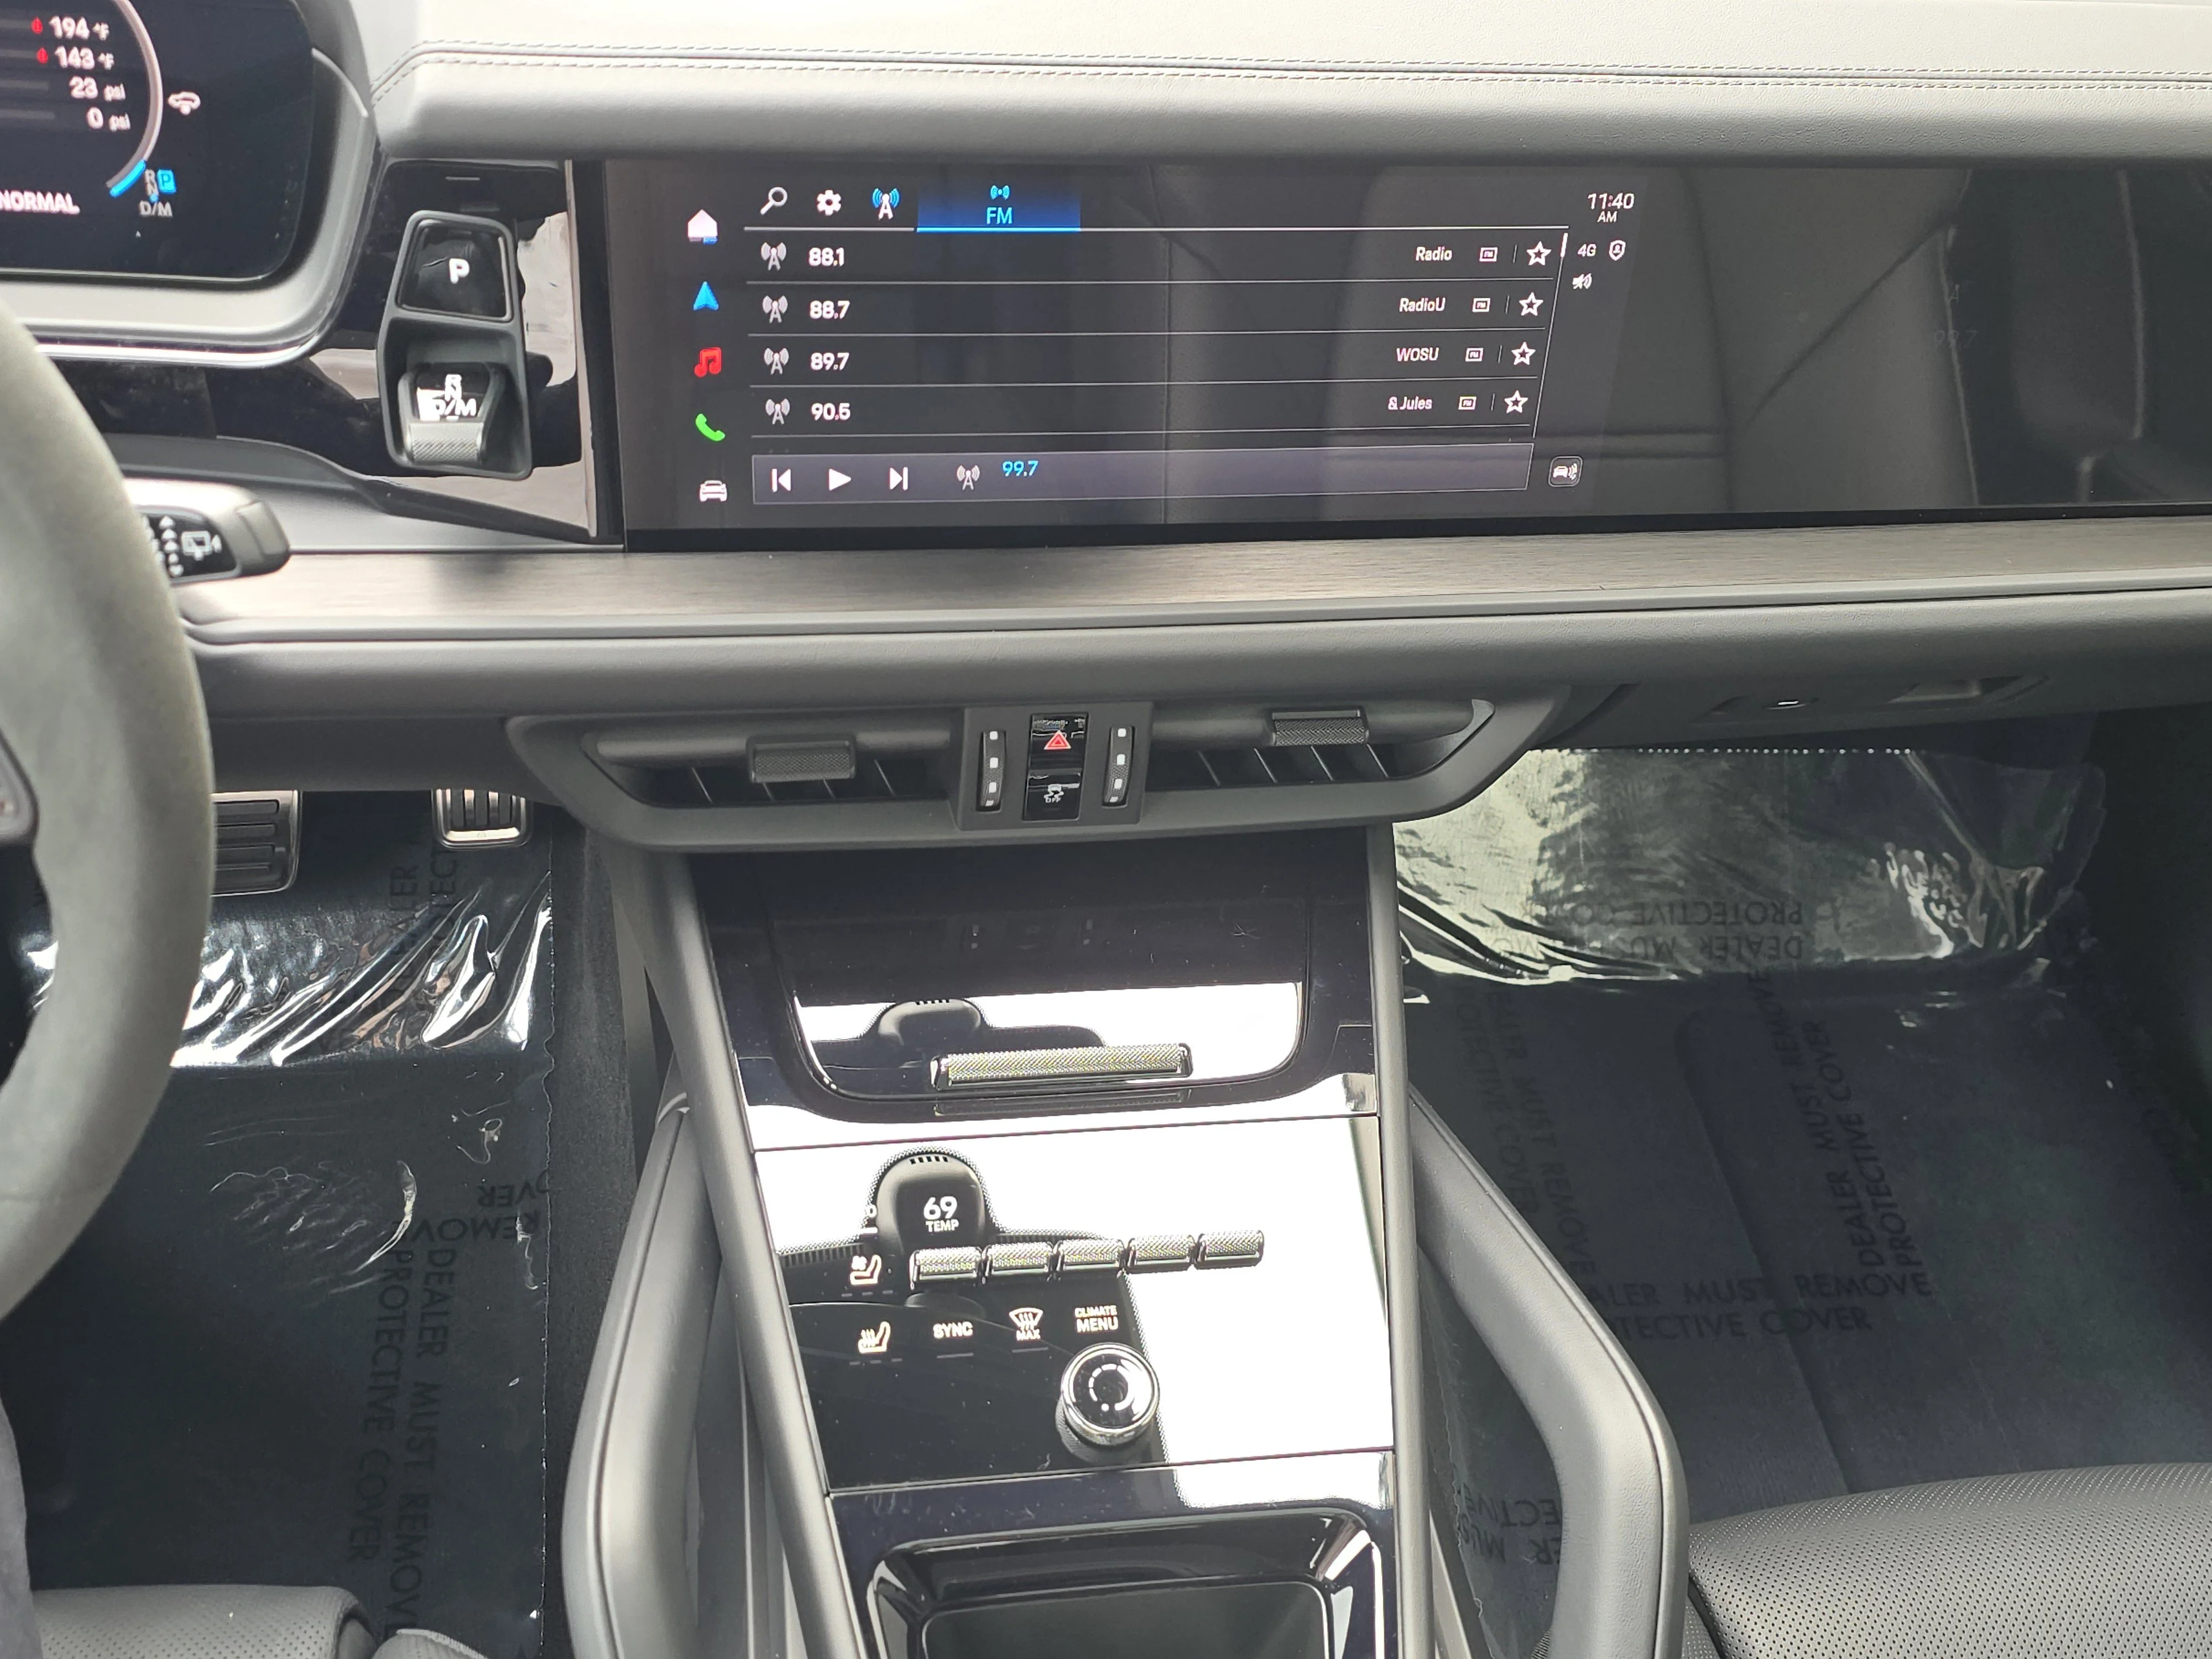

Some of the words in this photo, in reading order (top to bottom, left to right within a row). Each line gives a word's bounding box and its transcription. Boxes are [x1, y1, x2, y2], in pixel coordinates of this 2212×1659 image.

[49, 15, 90, 39] 194
[54, 46, 95, 70] 143
[69, 76, 98, 98] 23
[103, 82, 126, 102] psi
[86, 107, 103, 129] 0
[109, 113, 131, 132] psi
[145, 169, 155, 183] R
[0, 189, 80, 215] NORMAL
[139, 200, 173, 217] D/M
[1588, 192, 1635, 210] 11:40
[987, 207, 1013, 224] FM
[1597, 211, 1618, 222] AM
[808, 248, 845, 267] 88.1
[1415, 246, 1452, 262] Radio
[1578, 243, 1597, 257] 4G
[449, 258, 470, 284] P
[810, 300, 851, 319] 88.7
[1399, 296, 1446, 312] RadioU
[810, 352, 850, 371] 89.7
[1396, 347, 1439, 362] WOSU
[1399, 395, 1433, 410] Jules
[811, 403, 851, 421] 90.5
[1002, 460, 1039, 478] 99.7
[924, 1196, 957, 1220] 69
[926, 1219, 959, 1233] TEMP
[1826, 1170, 1886, 1267] DEALER
[1587, 1282, 1662, 1308] ALER
[1793, 1271, 1933, 1298] REMOVE
[417, 1249, 458, 1359] DEALER
[1074, 1305, 1117, 1317] CLIMATE
[933, 1321, 973, 1339] SYNC
[1077, 1316, 1118, 1333] MENU
[1016, 1329, 1041, 1341] MAX
[404, 1381, 441, 1472] MUST
[346, 1448, 391, 1564] COVER
